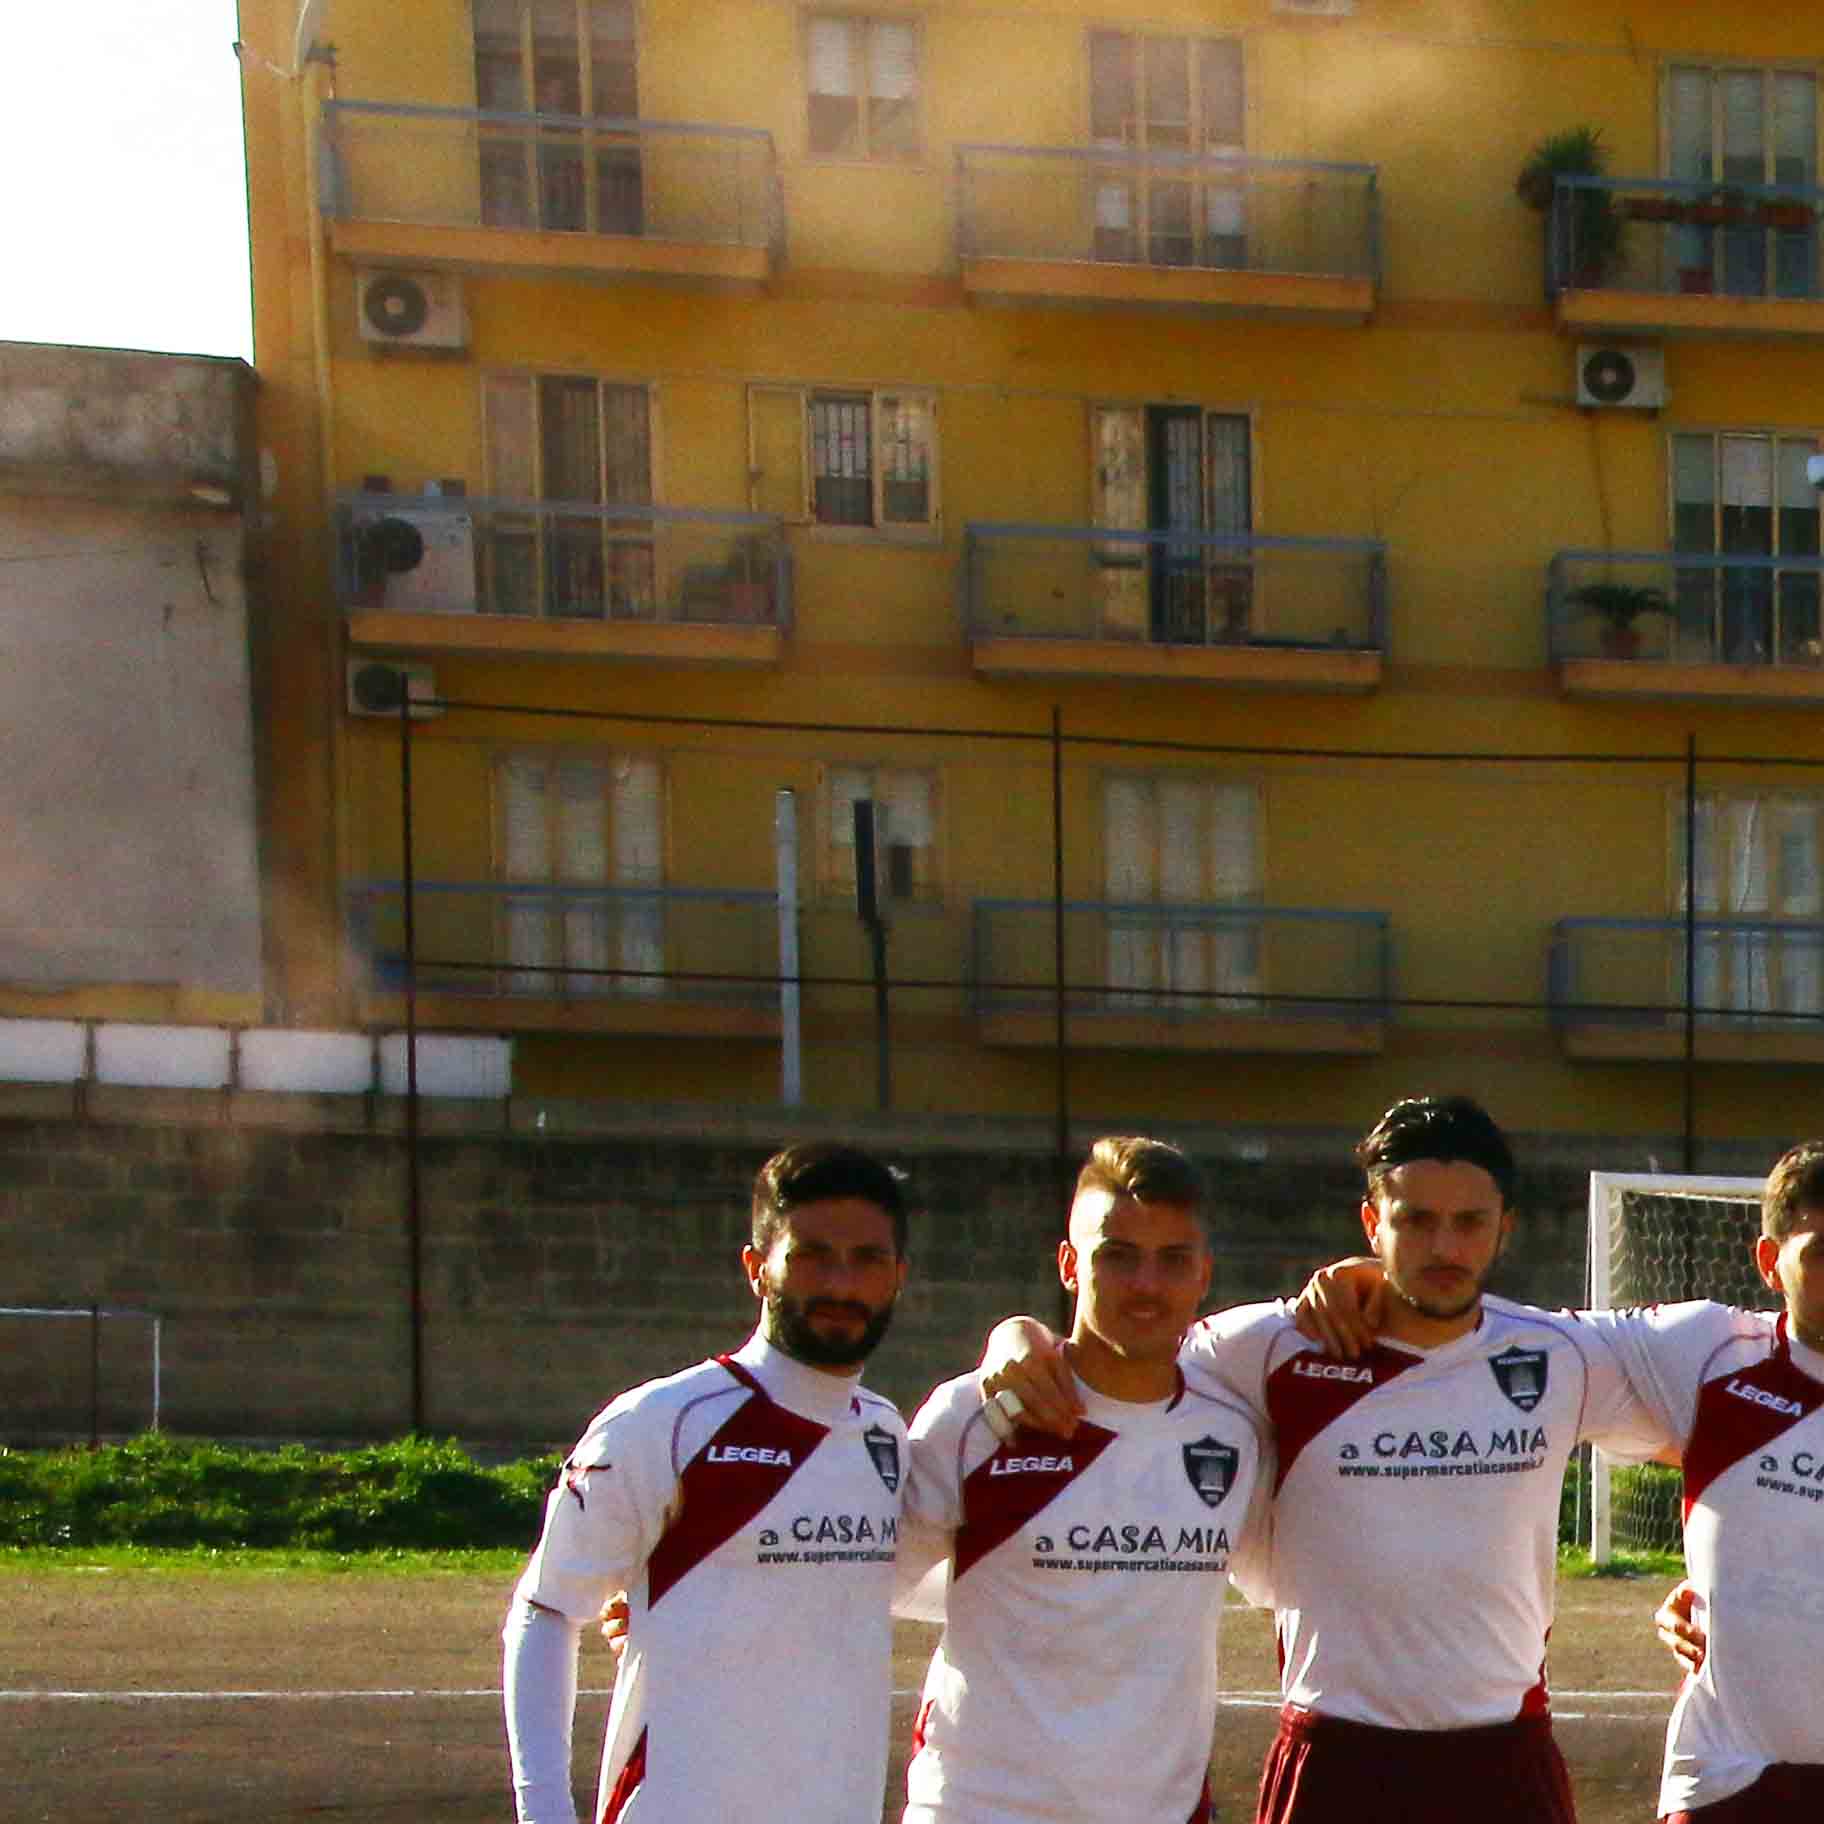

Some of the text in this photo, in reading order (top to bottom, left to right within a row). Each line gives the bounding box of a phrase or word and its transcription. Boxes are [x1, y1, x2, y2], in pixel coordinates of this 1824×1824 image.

[1291, 1361, 1374, 1384] LEGEA
[1724, 1378, 1802, 1417] LEGEA
[1339, 1425, 1548, 1460] a CASA MIA
[706, 1446, 792, 1467] LEGEA
[990, 1456, 1073, 1476] LEGEA
[1759, 1455, 1778, 1472] a
[760, 1529, 779, 1546] a
[792, 1514, 876, 1544] CASA
[1035, 1525, 1230, 1554] a CASA MIA
